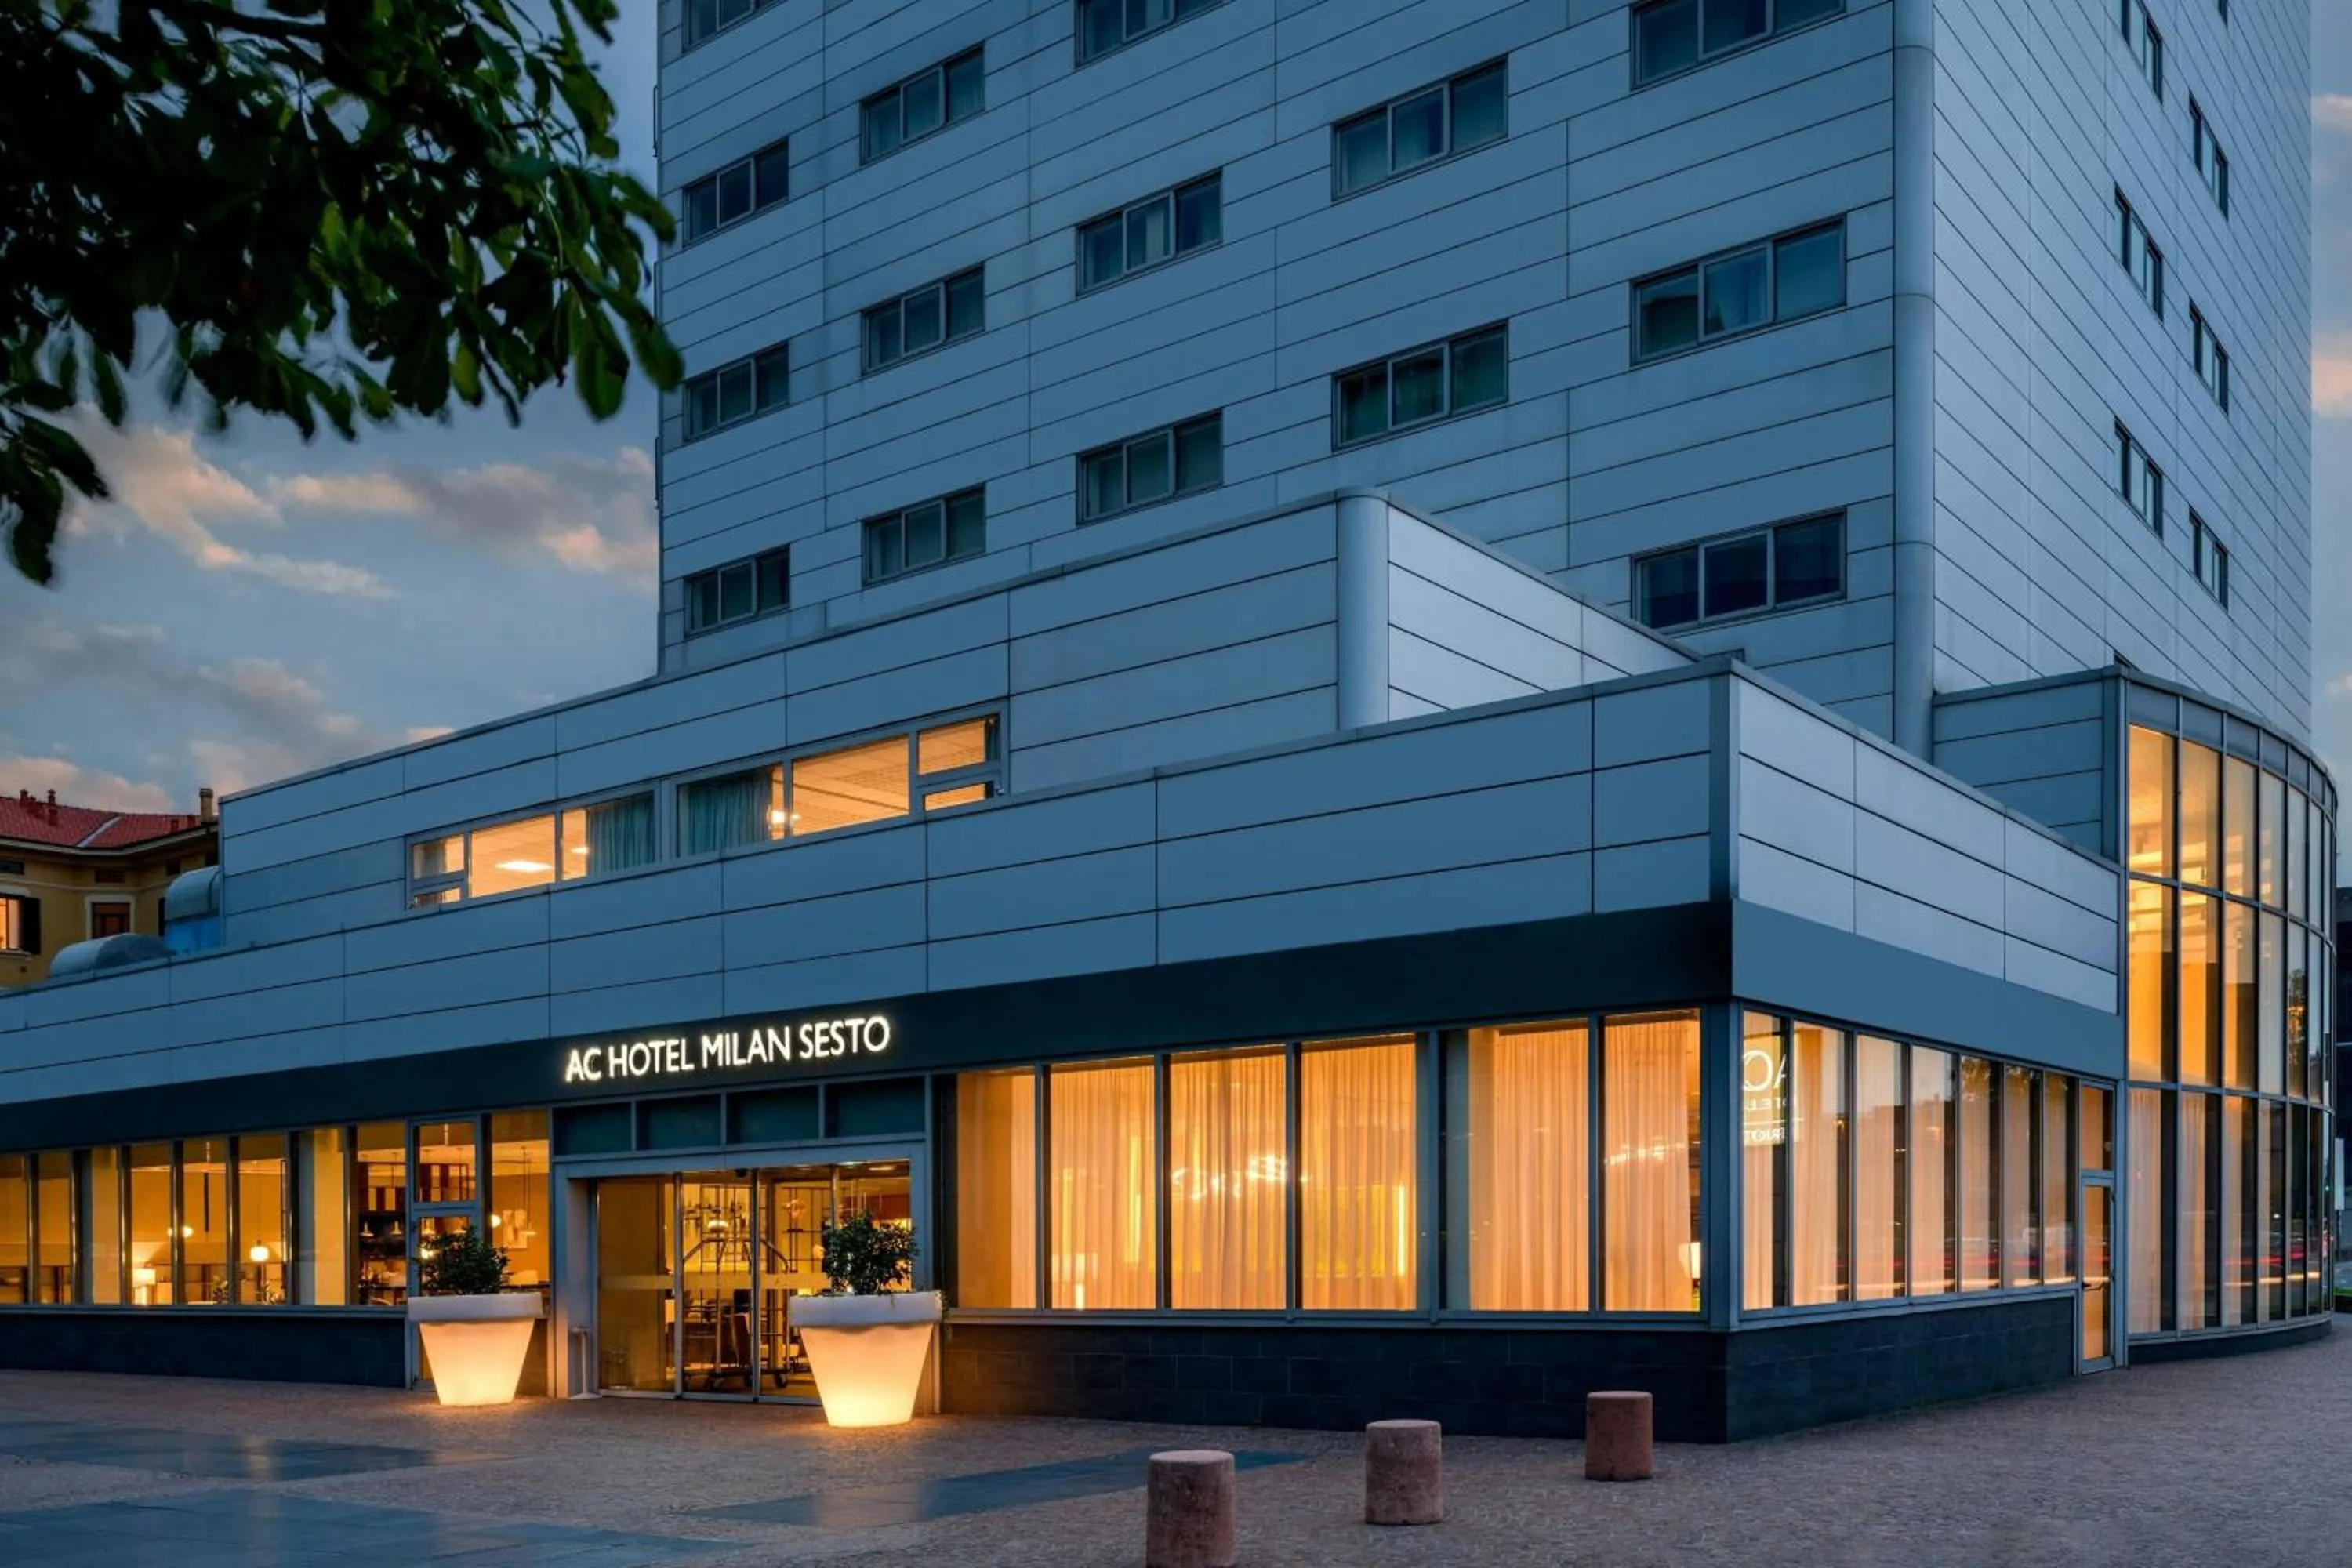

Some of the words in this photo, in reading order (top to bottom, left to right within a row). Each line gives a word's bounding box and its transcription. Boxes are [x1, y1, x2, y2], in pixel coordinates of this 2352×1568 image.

[565, 1047, 601, 1082] AC
[608, 1038, 695, 1078] HOTEL
[701, 1026, 790, 1068] MILAN
[800, 1015, 890, 1058] SESTO
